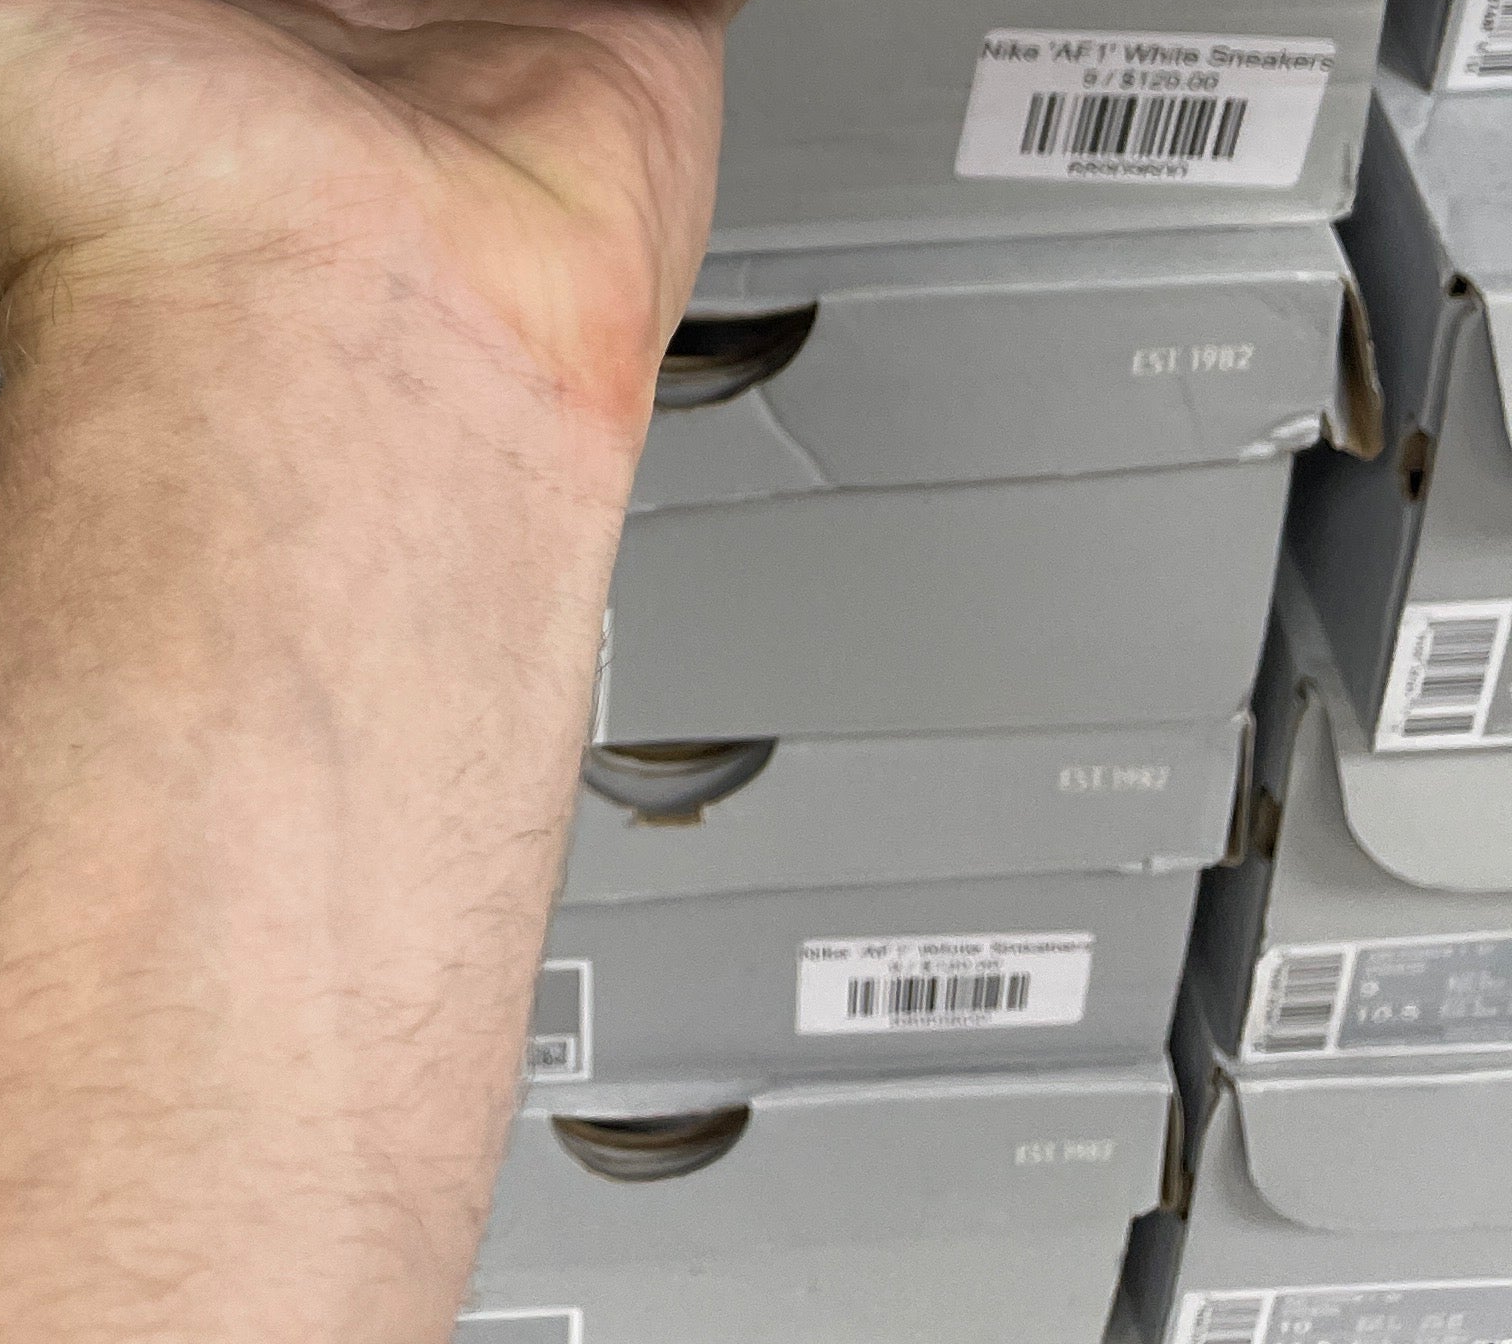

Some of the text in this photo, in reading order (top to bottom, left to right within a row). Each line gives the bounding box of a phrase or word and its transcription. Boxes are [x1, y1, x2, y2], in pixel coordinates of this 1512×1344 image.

[981, 41, 1040, 64] Nike
[1123, 43, 1201, 67] White
[1207, 44, 1335, 73] Sneakers
